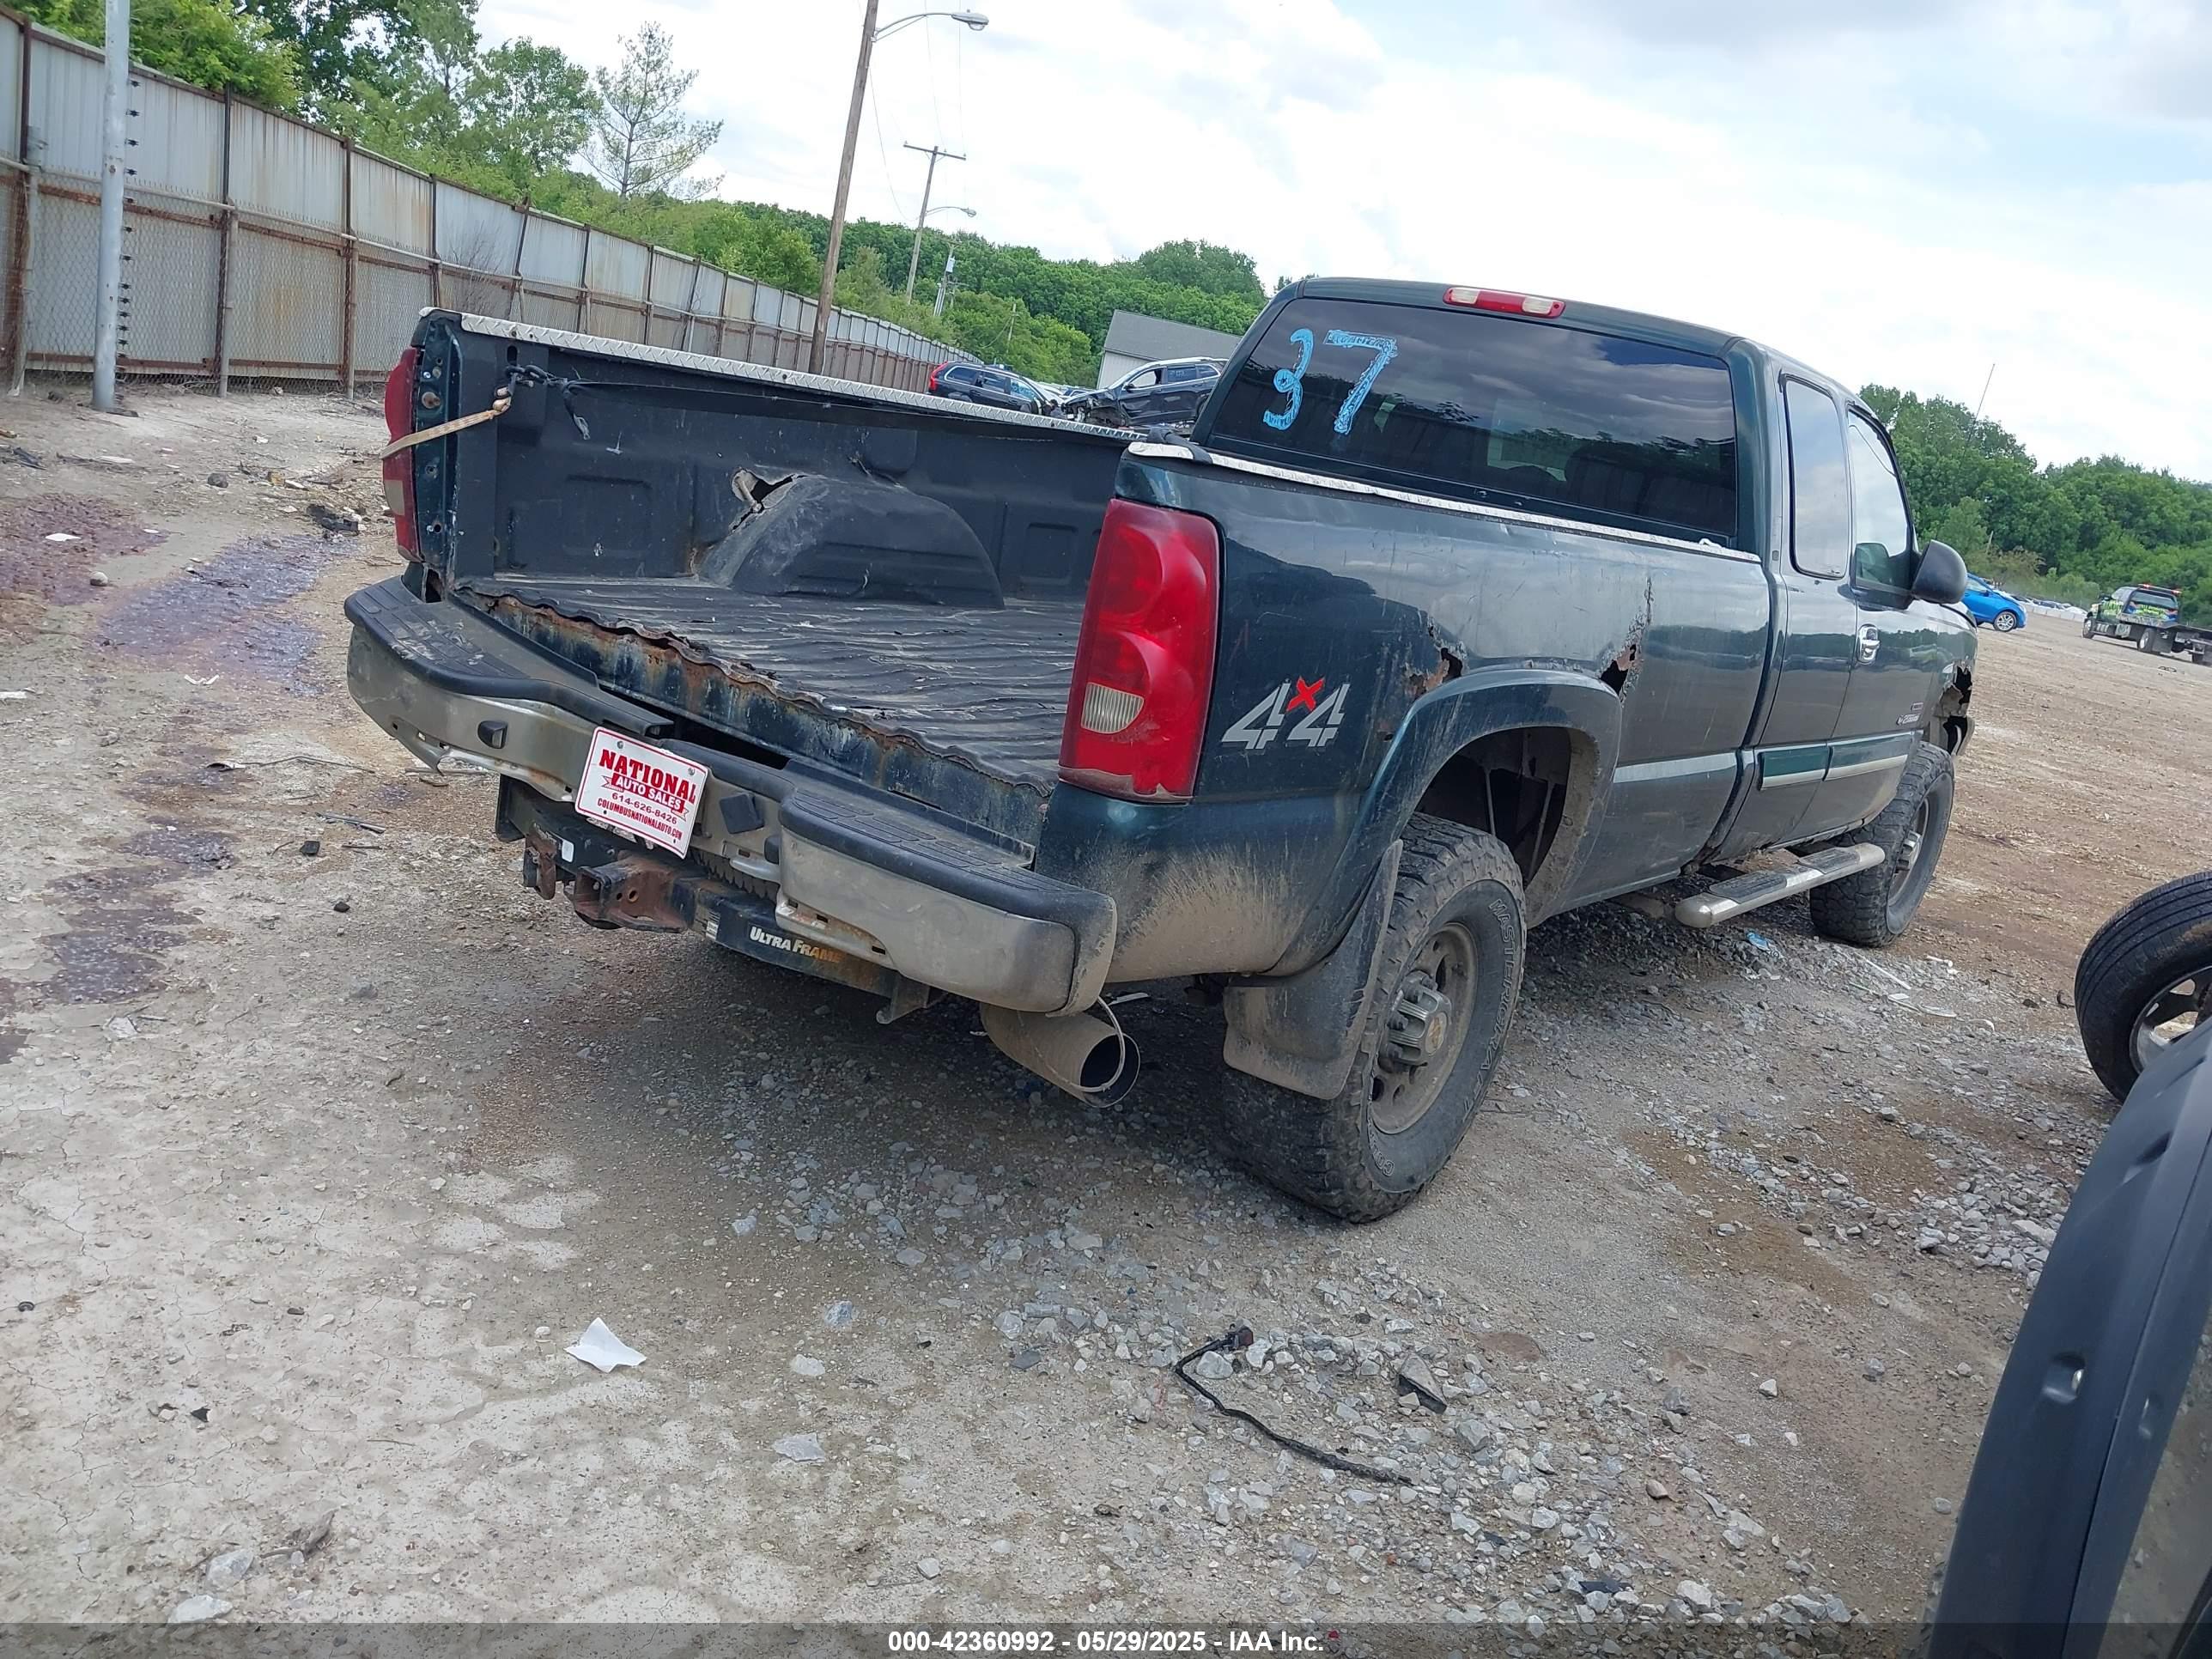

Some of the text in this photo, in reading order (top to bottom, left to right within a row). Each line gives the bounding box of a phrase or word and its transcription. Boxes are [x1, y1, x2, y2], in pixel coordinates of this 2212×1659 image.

[1263, 328, 1397, 435] 37
[599, 749, 697, 805] NATIONAL
[616, 777, 682, 811] AUTO SALES
[611, 792, 678, 824] 614-626-8426
[750, 926, 844, 963] ULTRA FRAME
